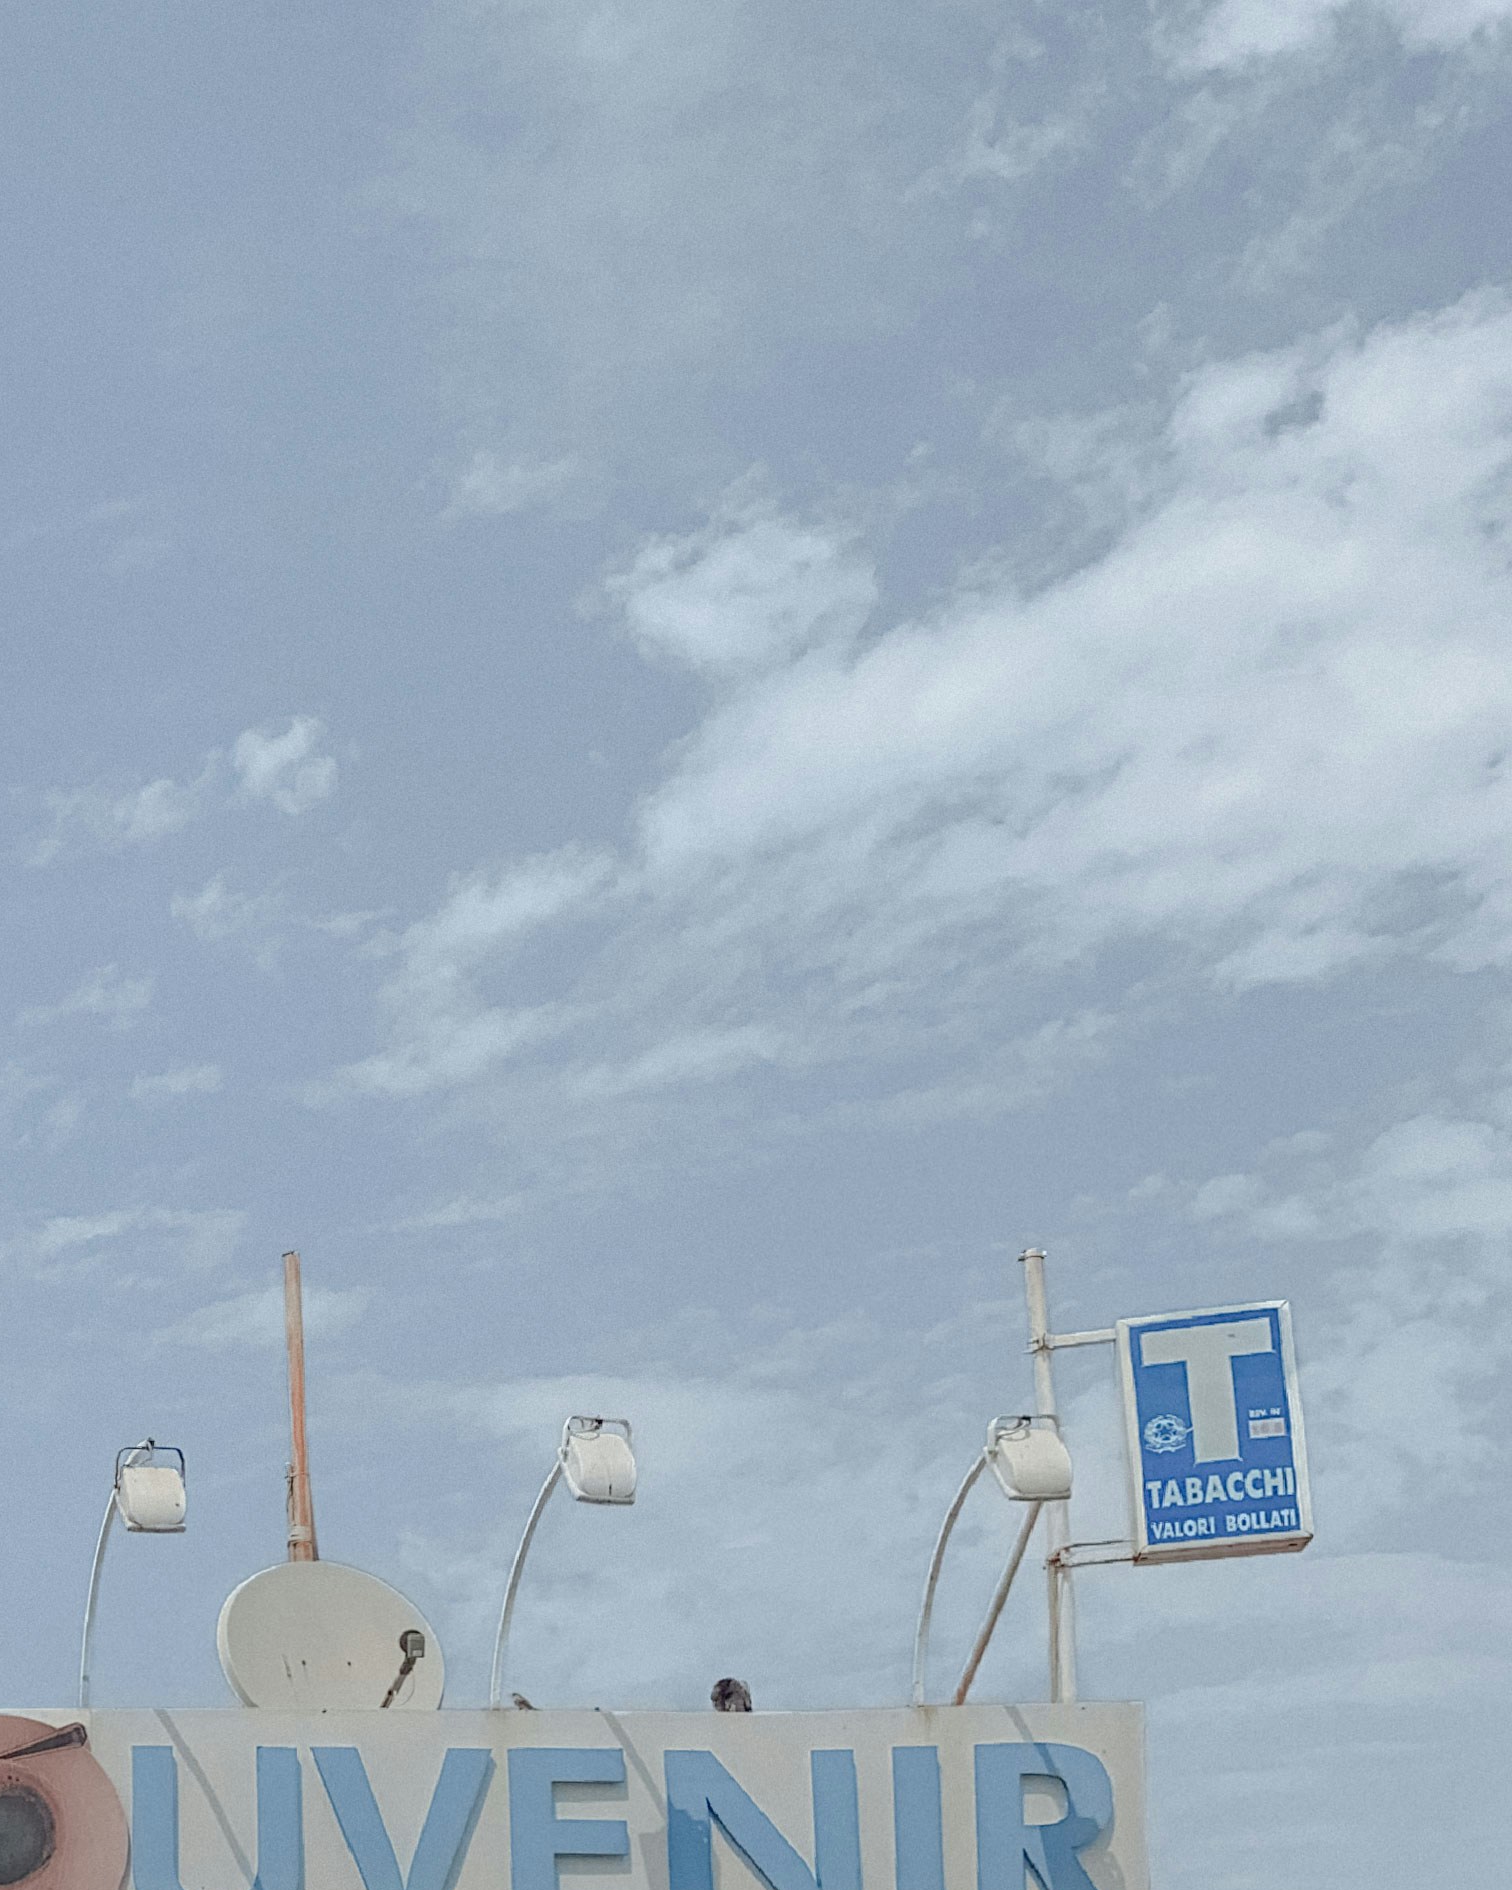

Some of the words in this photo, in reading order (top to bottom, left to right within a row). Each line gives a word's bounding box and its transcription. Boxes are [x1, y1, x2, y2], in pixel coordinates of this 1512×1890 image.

[1139, 1318, 1276, 1465] T
[1146, 1467, 1295, 1509] TABACCHI
[1151, 1516, 1216, 1540] VALORI
[1225, 1509, 1297, 1533] BOLLATI
